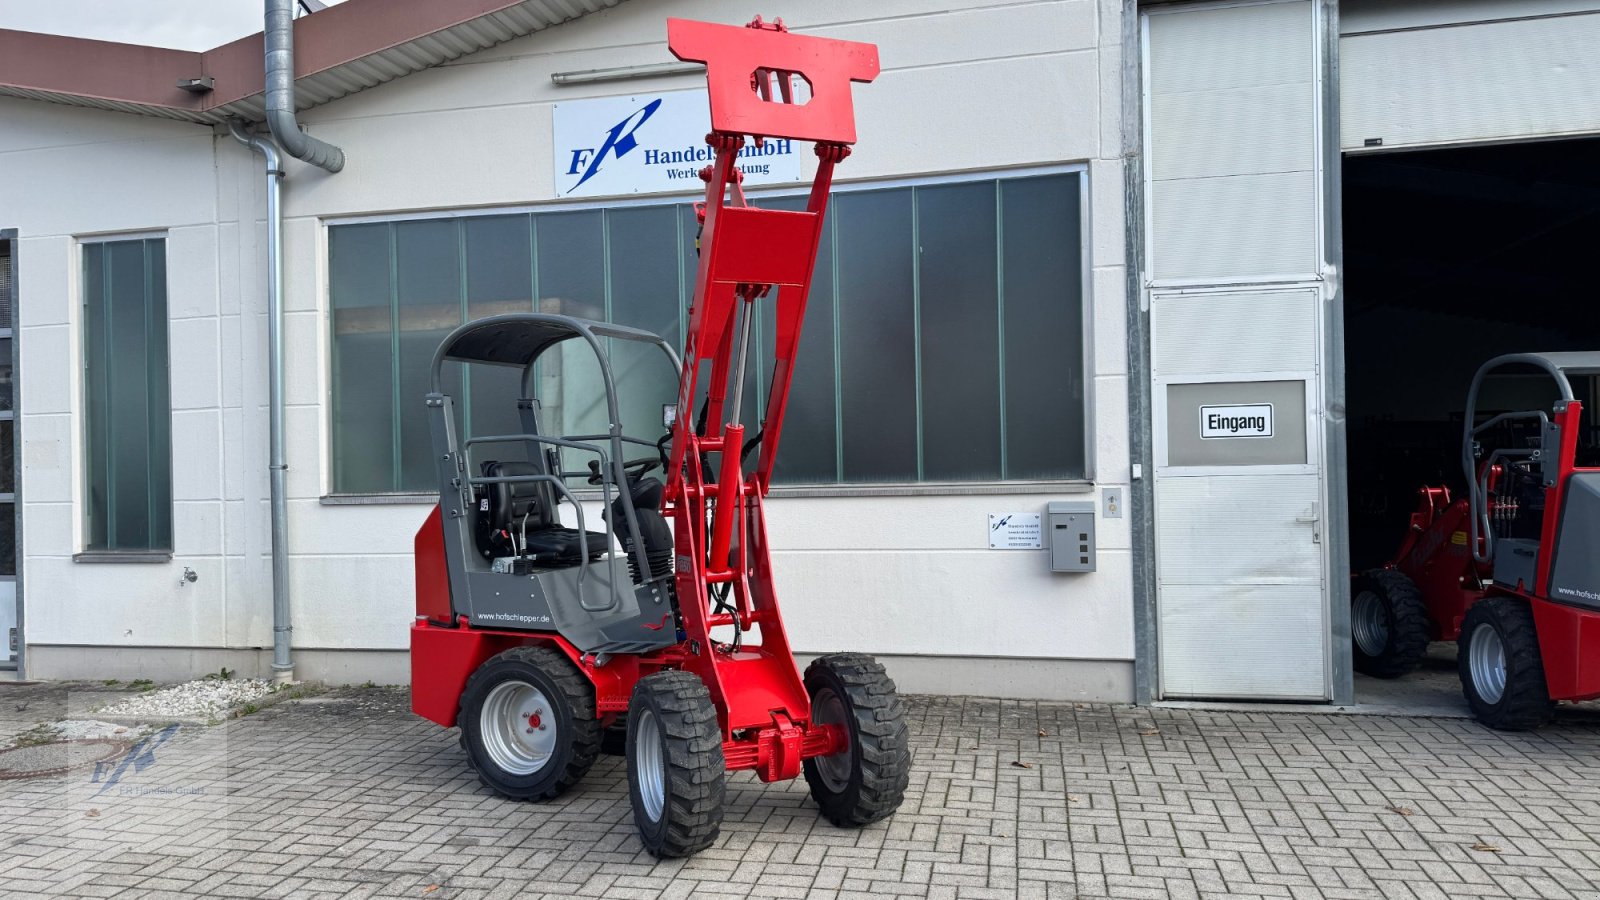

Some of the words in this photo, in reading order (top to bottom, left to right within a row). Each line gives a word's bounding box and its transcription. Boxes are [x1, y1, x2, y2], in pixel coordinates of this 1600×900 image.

[644, 145, 717, 165] Handel
[1208, 414, 1265, 432] Eingang
[478, 612, 550, 623] www.hofschlepper.de
